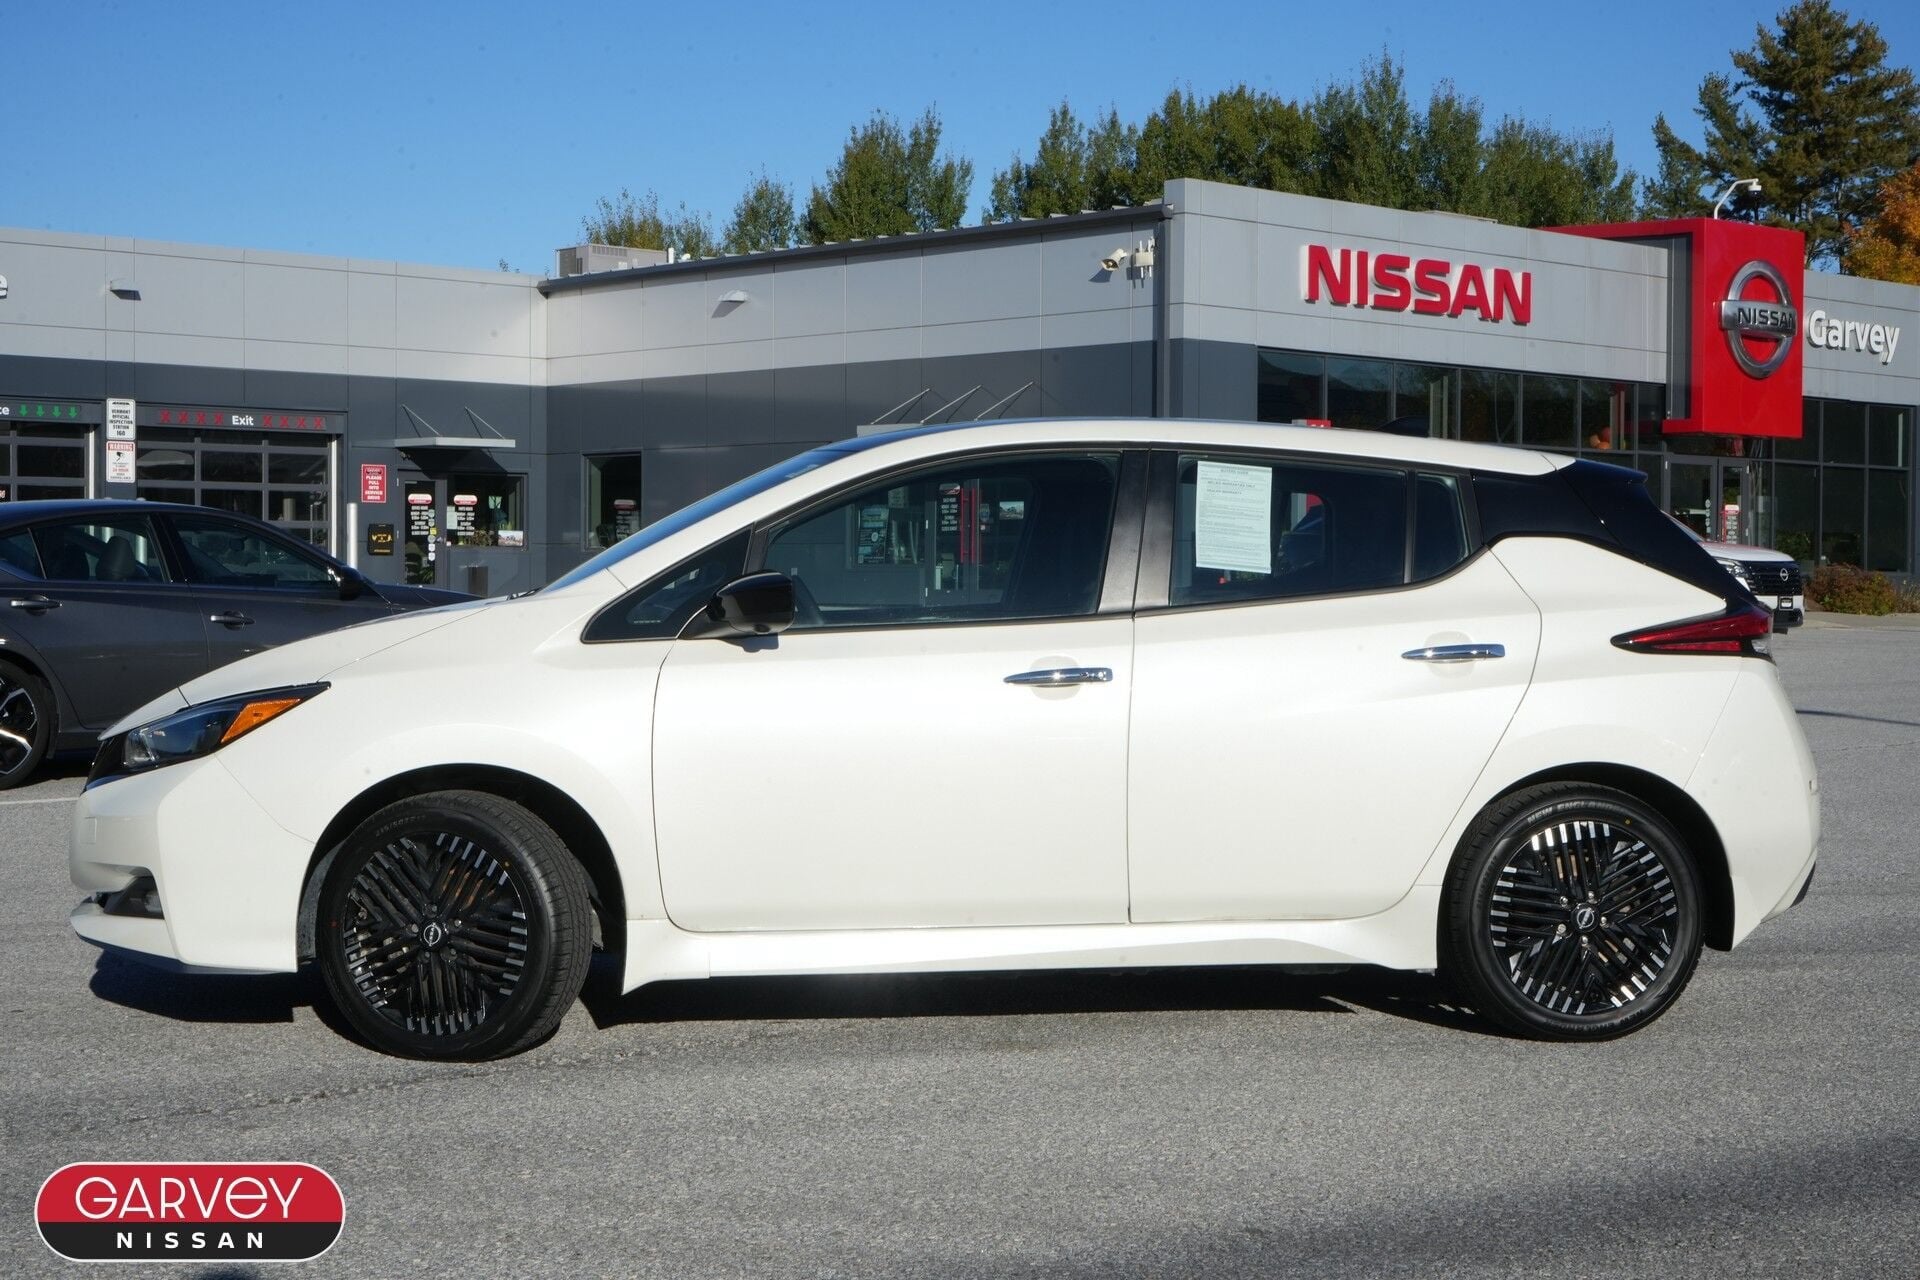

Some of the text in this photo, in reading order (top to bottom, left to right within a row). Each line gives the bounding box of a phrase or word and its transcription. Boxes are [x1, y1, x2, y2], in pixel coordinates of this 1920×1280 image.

[1306, 244, 1532, 325] NISSAN
[1808, 310, 1900, 364] Garvey
[232, 415, 254, 426] Exit
